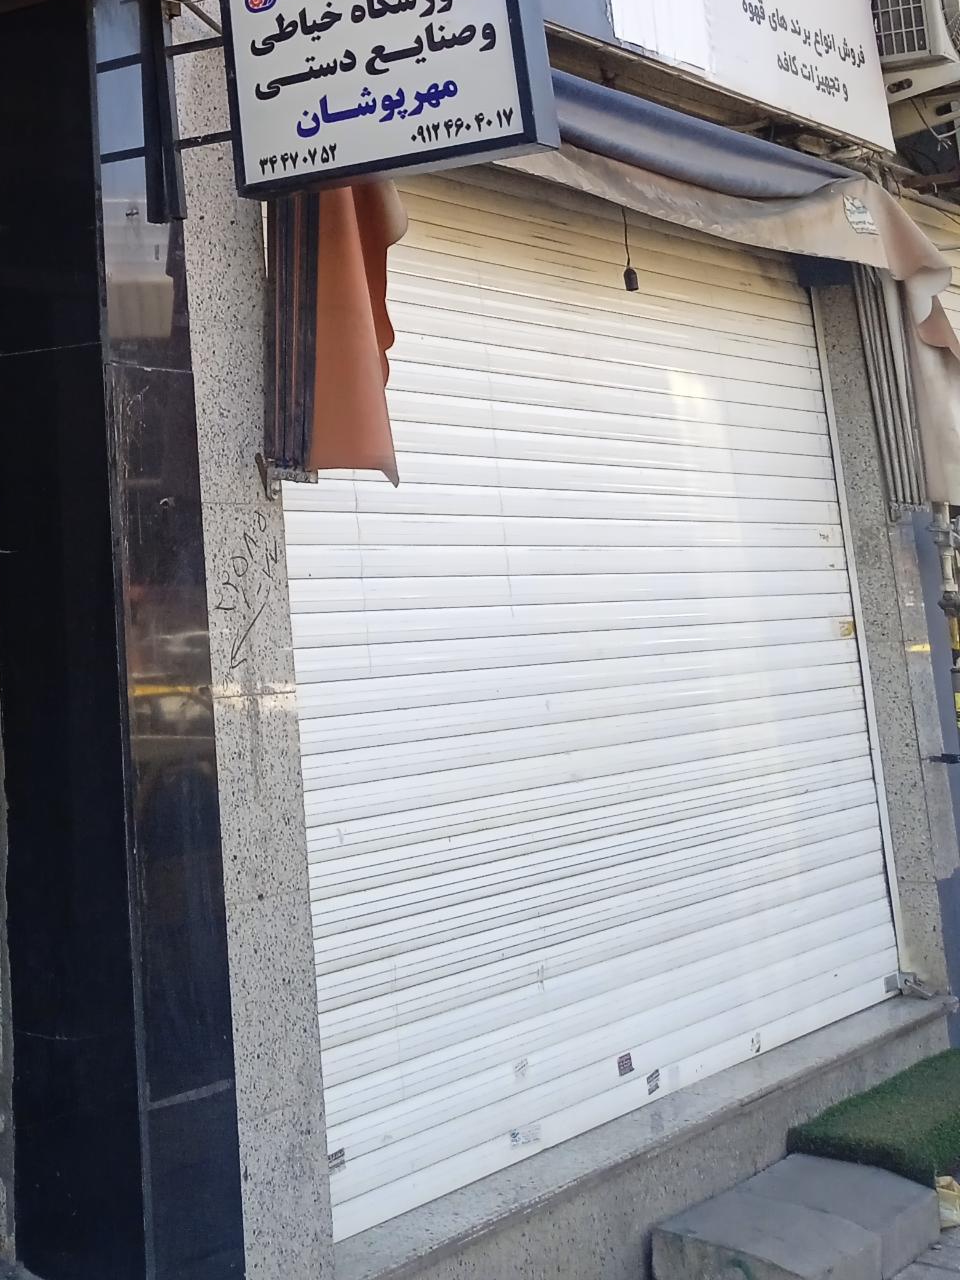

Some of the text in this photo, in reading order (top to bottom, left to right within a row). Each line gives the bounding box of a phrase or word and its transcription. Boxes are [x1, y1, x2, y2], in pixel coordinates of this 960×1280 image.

[250, 1, 343, 57] خیاطی
[768, 7, 788, 32] های
[814, 28, 836, 58] انواع
[837, 37, 865, 68] فروش
[254, 48, 358, 101] دستی
[777, 51, 849, 102] و تجهیزات کافه
